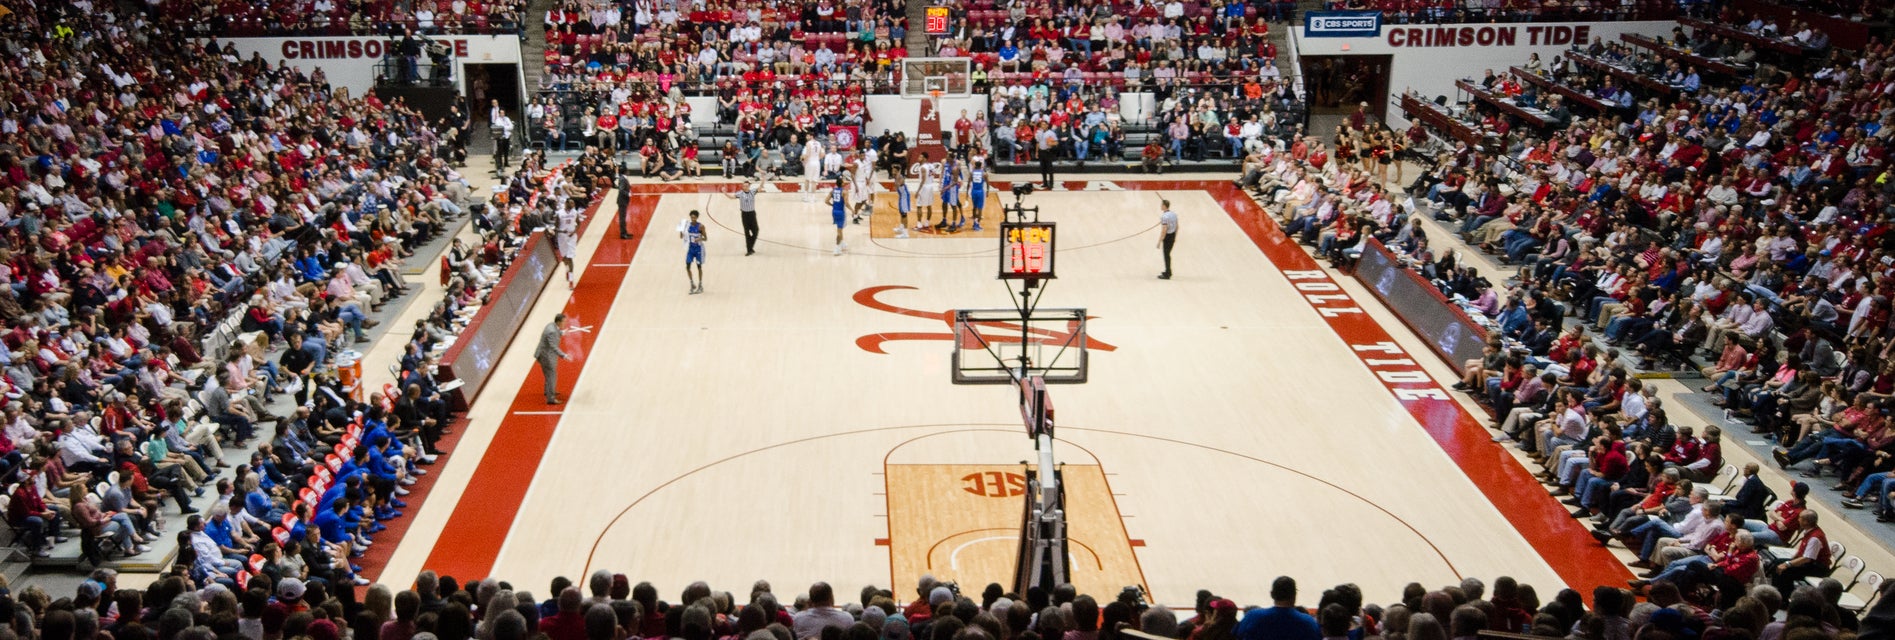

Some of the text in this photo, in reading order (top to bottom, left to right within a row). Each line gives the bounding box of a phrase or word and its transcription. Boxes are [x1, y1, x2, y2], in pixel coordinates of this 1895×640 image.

[928, 17, 944, 31] 30
[1325, 19, 1373, 28] CBS SPORTS
[1388, 26, 1590, 47] CRIMSON TIDE
[1282, 269, 1364, 318] ROLL
[1351, 341, 1451, 401] TIDE
[960, 471, 1026, 498] SEC
